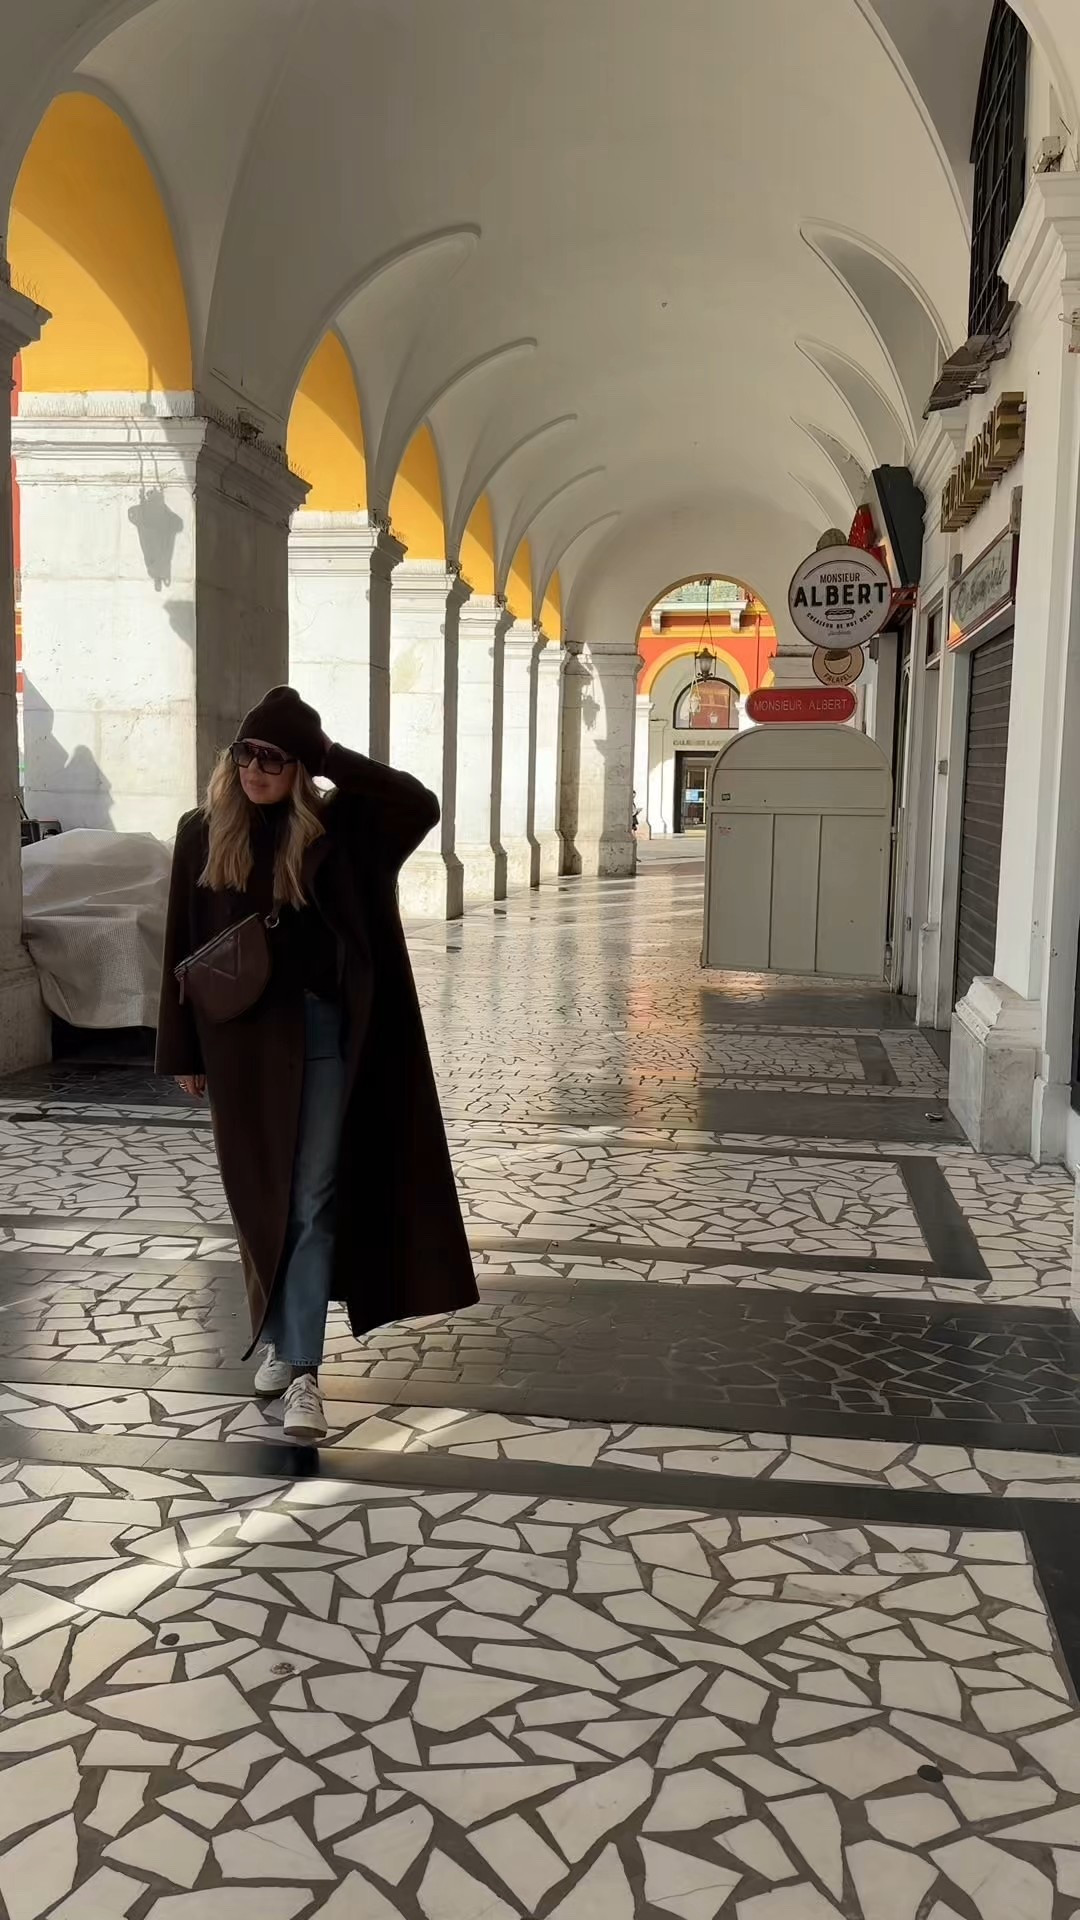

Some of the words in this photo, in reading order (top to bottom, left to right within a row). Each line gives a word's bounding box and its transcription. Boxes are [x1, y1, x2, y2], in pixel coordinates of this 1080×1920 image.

[820, 573, 860, 583] MONSIEUR
[794, 582, 888, 608] ALBERT
[823, 673, 853, 683] FALAFEL
[754, 700, 801, 711] MONSIEUR
[809, 699, 848, 710] ALBERT
